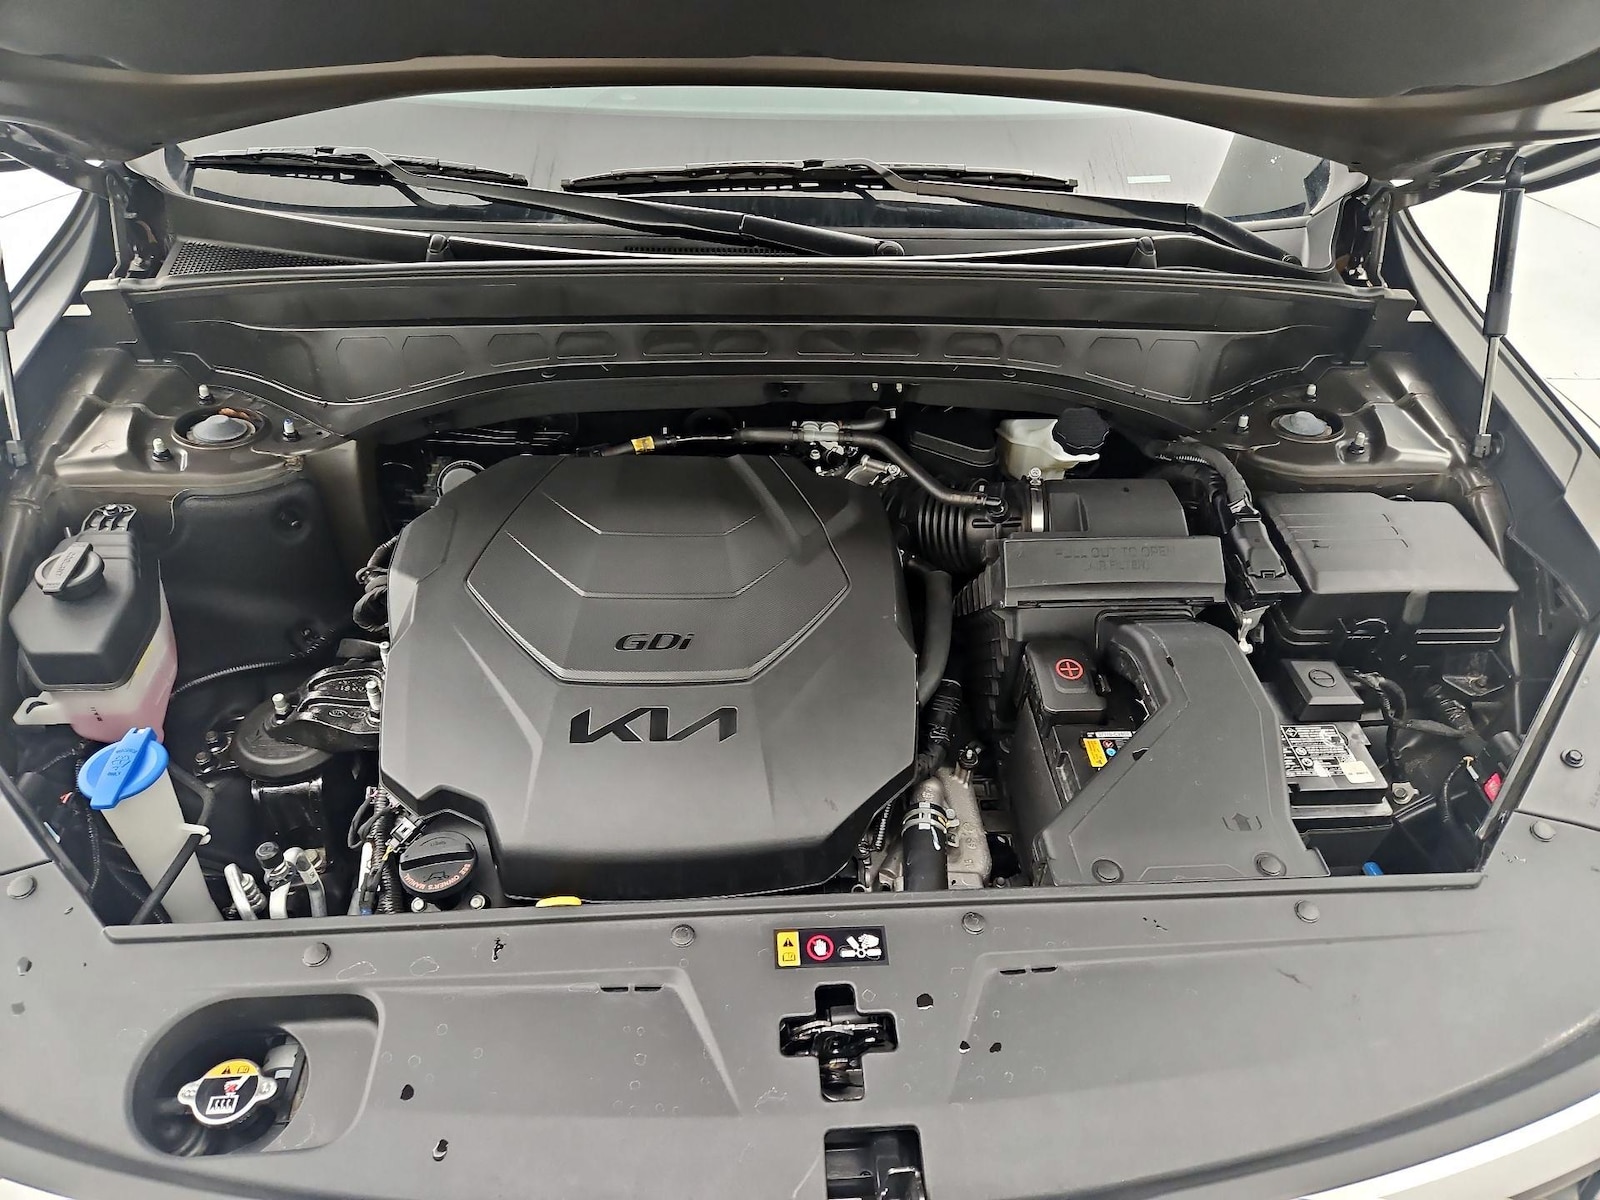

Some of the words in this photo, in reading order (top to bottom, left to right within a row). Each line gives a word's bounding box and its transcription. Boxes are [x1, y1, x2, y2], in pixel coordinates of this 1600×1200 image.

[1090, 546, 1119, 559] OUT
[1122, 546, 1138, 558] TO
[614, 632, 696, 651] GDi
[569, 705, 739, 744] KIA
[427, 874, 460, 890] OWNER'S
